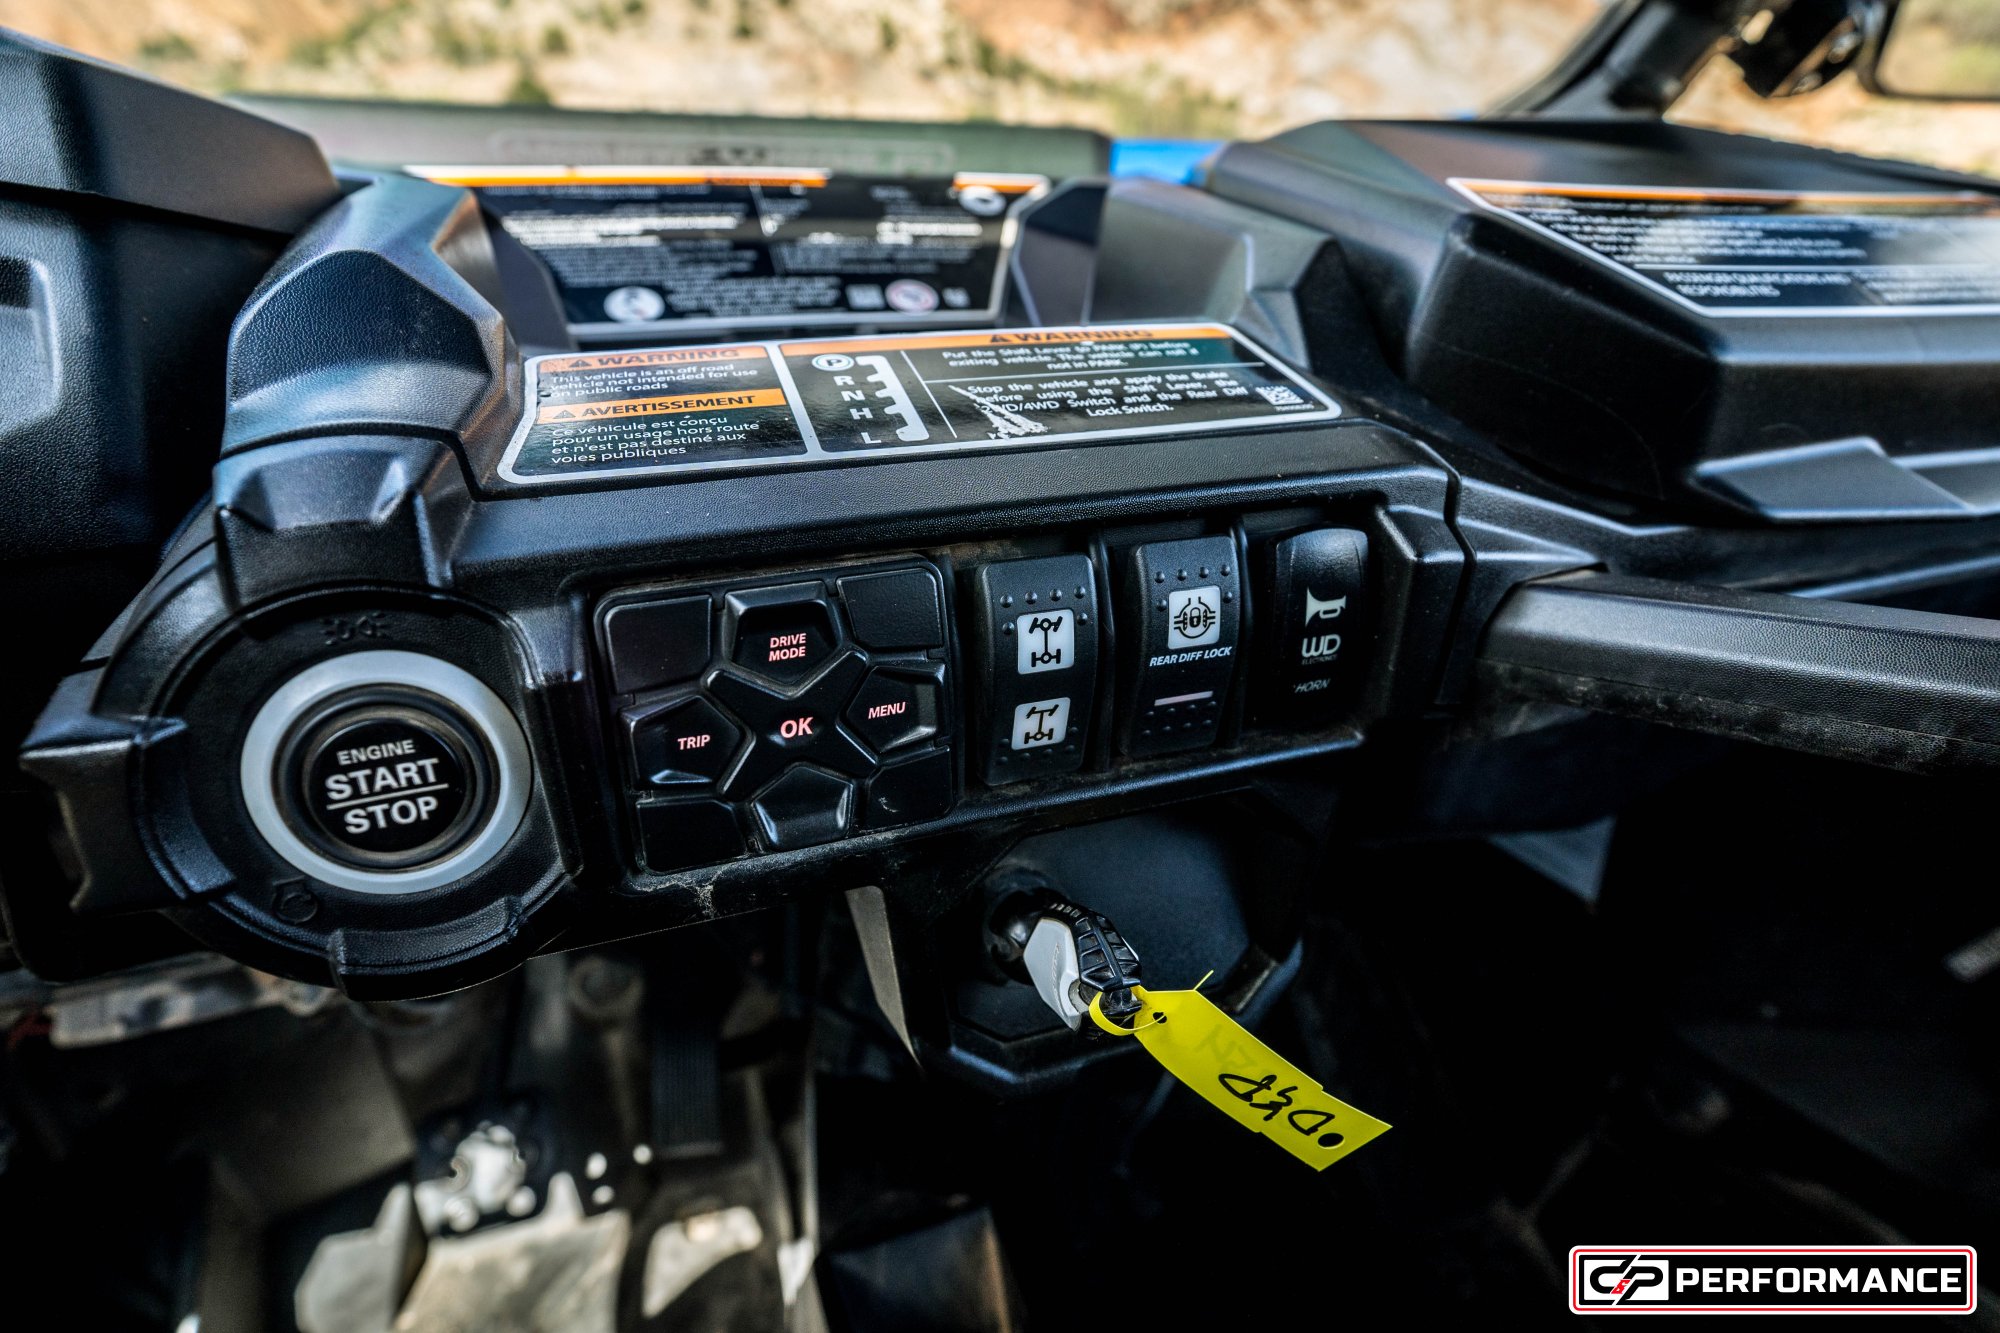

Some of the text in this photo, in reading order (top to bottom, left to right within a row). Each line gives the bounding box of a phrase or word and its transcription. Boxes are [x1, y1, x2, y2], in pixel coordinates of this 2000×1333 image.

[1013, 330, 1153, 341] WARNING
[598, 349, 739, 365] WARNING
[949, 358, 999, 367] exiting
[1088, 350, 1135, 359] vehicle
[998, 347, 1032, 356] Shift
[826, 358, 842, 367] P
[1047, 362, 1073, 370] not
[550, 380, 604, 391] vehicle
[608, 377, 634, 385] not
[637, 373, 705, 384] intended
[732, 369, 758, 377] use
[551, 374, 581, 383] This
[584, 370, 637, 380] vehicle
[655, 368, 674, 376] an
[677, 365, 698, 373] off
[701, 364, 734, 372] road
[833, 375, 855, 386] R
[967, 371, 1230, 394] Stop the vehicle and apply the Brake
[550, 382, 669, 398] on public roads
[841, 390, 866, 401] N
[976, 394, 1024, 403] efore
[1036, 390, 1078, 400] using
[1087, 387, 1114, 396] the
[1123, 384, 1158, 393] Shift
[1214, 379, 1239, 388] the
[582, 395, 755, 417] AVERTISSEMENT
[980, 386, 1249, 413] 2D/4WD Switch and the Rear Diff
[849, 407, 874, 420] H
[1086, 403, 1174, 417] Lock Switch.
[552, 416, 728, 436] Ce véhicule est conçu
[551, 433, 747, 454] et n'est pas destiné aux
[552, 436, 593, 446] pour
[623, 430, 673, 439] usage
[676, 427, 713, 435] hors
[861, 432, 882, 444] L
[551, 446, 687, 464] voies publiques
[769, 633, 807, 649] DRIVE
[1301, 633, 1341, 658] WD
[768, 646, 806, 662] MODE
[1149, 646, 1232, 667] REAR DIFF LOCK
[1295, 678, 1331, 693] HORN
[867, 702, 906, 720] MENU
[780, 717, 813, 739] OK
[677, 734, 711, 751] TRIP
[336, 739, 416, 766] ENGINE
[324, 758, 440, 800] START
[344, 795, 438, 834] STOP
